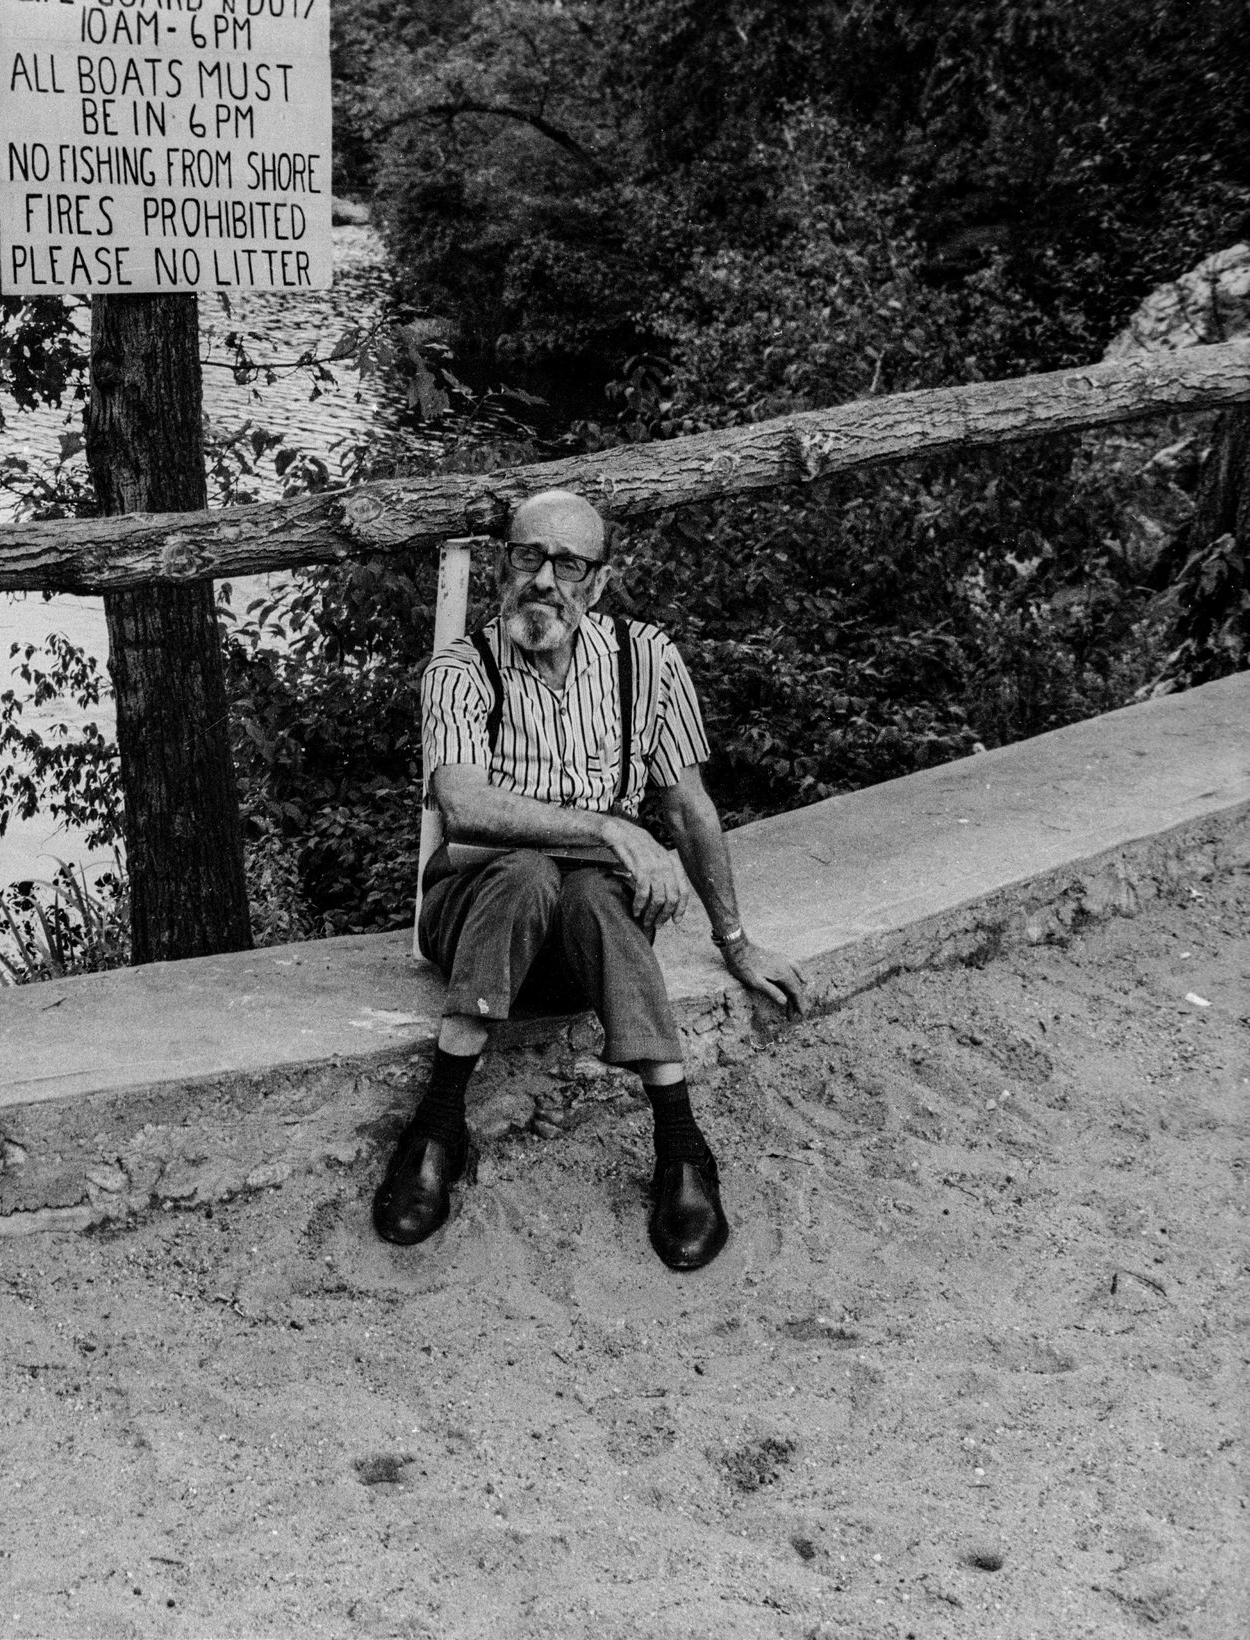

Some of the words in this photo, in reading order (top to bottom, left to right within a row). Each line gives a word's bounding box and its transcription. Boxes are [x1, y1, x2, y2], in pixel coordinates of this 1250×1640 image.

[10, 52, 65, 94] ALL
[77, 55, 183, 99] BOATS
[198, 60, 294, 103] MUST
[81, 97, 119, 137] BE
[132, 100, 166, 137] IN
[188, 103, 254, 139] 6PM
[8, 141, 50, 182] NO
[59, 144, 156, 188] FISHING
[166, 147, 233, 190] FROM
[247, 150, 322, 194] SHORE
[25, 193, 115, 237] FIRES
[143, 196, 306, 241] PROHIBITED
[11, 244, 133, 287] PLEASE
[154, 247, 201, 287] NO
[213, 249, 312, 287] LITTER
